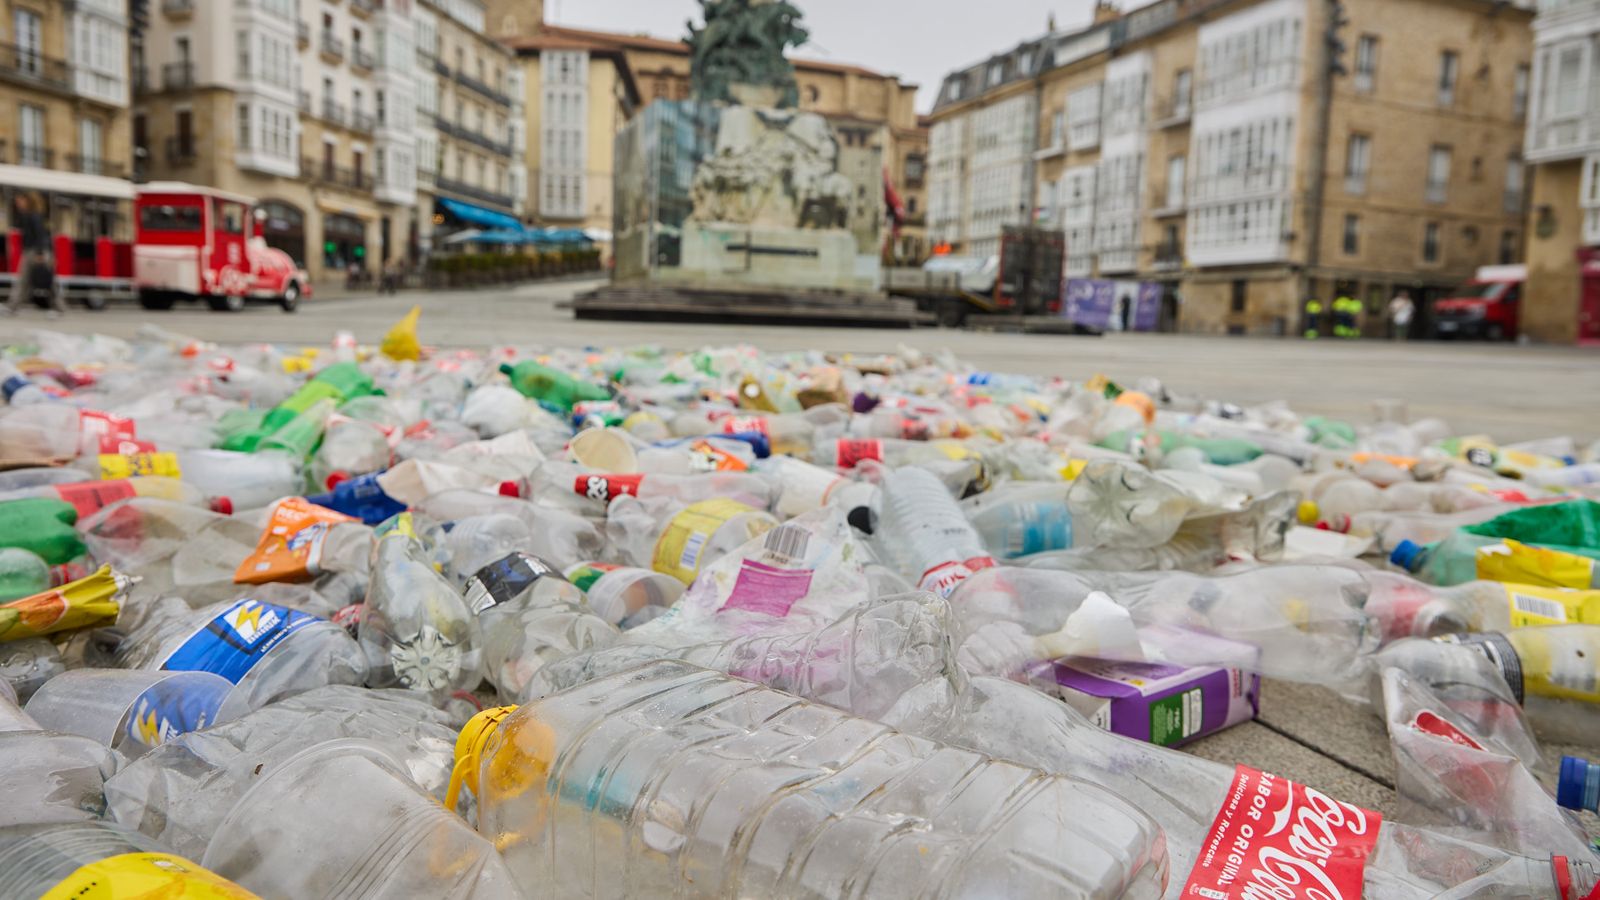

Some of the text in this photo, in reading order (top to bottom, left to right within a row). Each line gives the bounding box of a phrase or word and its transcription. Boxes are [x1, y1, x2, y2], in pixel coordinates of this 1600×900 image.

[1223, 810, 1233, 819] y
[1229, 774, 1249, 813] Deliciosa
[1247, 772, 1275, 820] SABOR
[1202, 819, 1230, 868] Refrescante
[1217, 823, 1254, 886] ORIGINAL
[1241, 785, 1367, 900] Coca-Co
